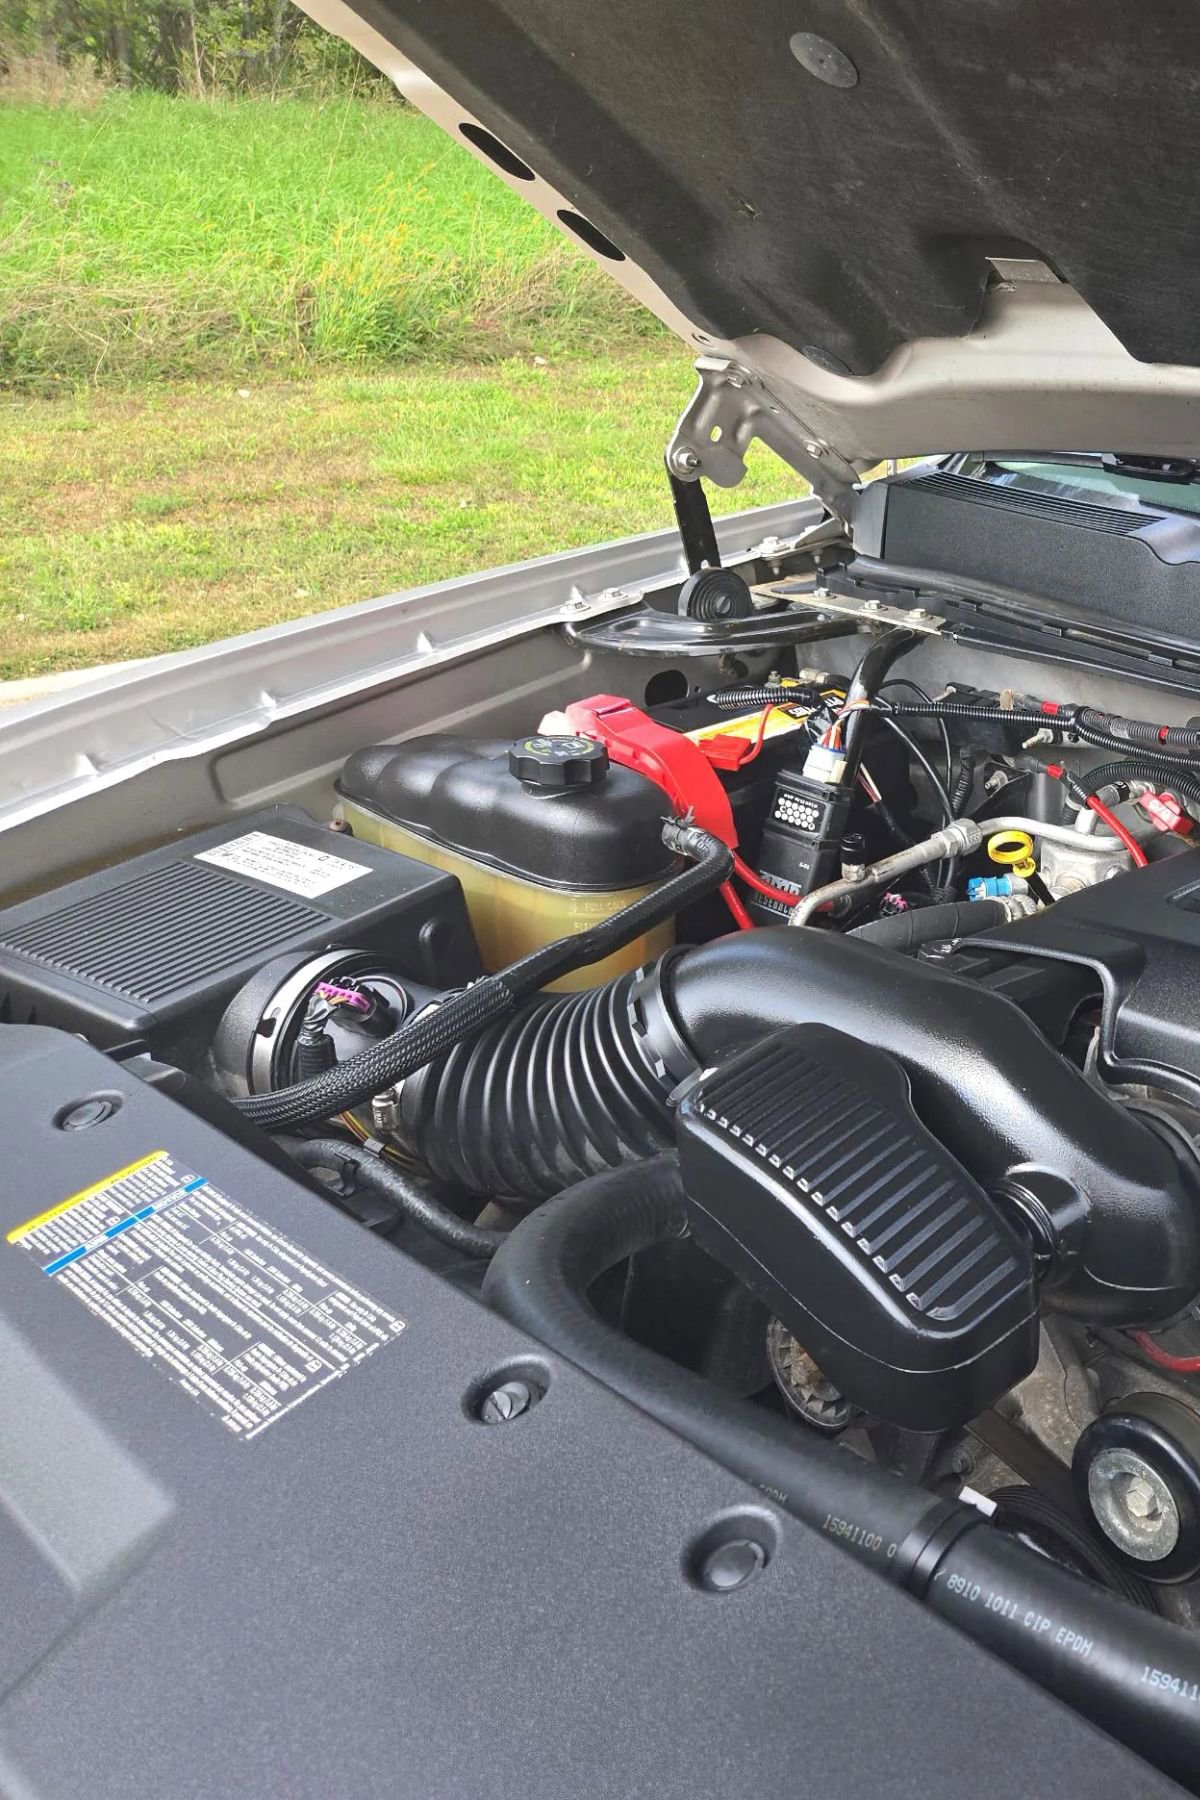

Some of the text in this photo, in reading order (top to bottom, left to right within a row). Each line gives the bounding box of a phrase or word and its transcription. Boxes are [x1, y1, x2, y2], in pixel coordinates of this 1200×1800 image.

[822, 1514, 883, 1551] 15941100
[947, 1573, 981, 1601] 8910
[984, 1592, 1019, 1620] 1011
[1023, 1611, 1051, 1633] CIP
[1055, 1627, 1094, 1658] EPDM
